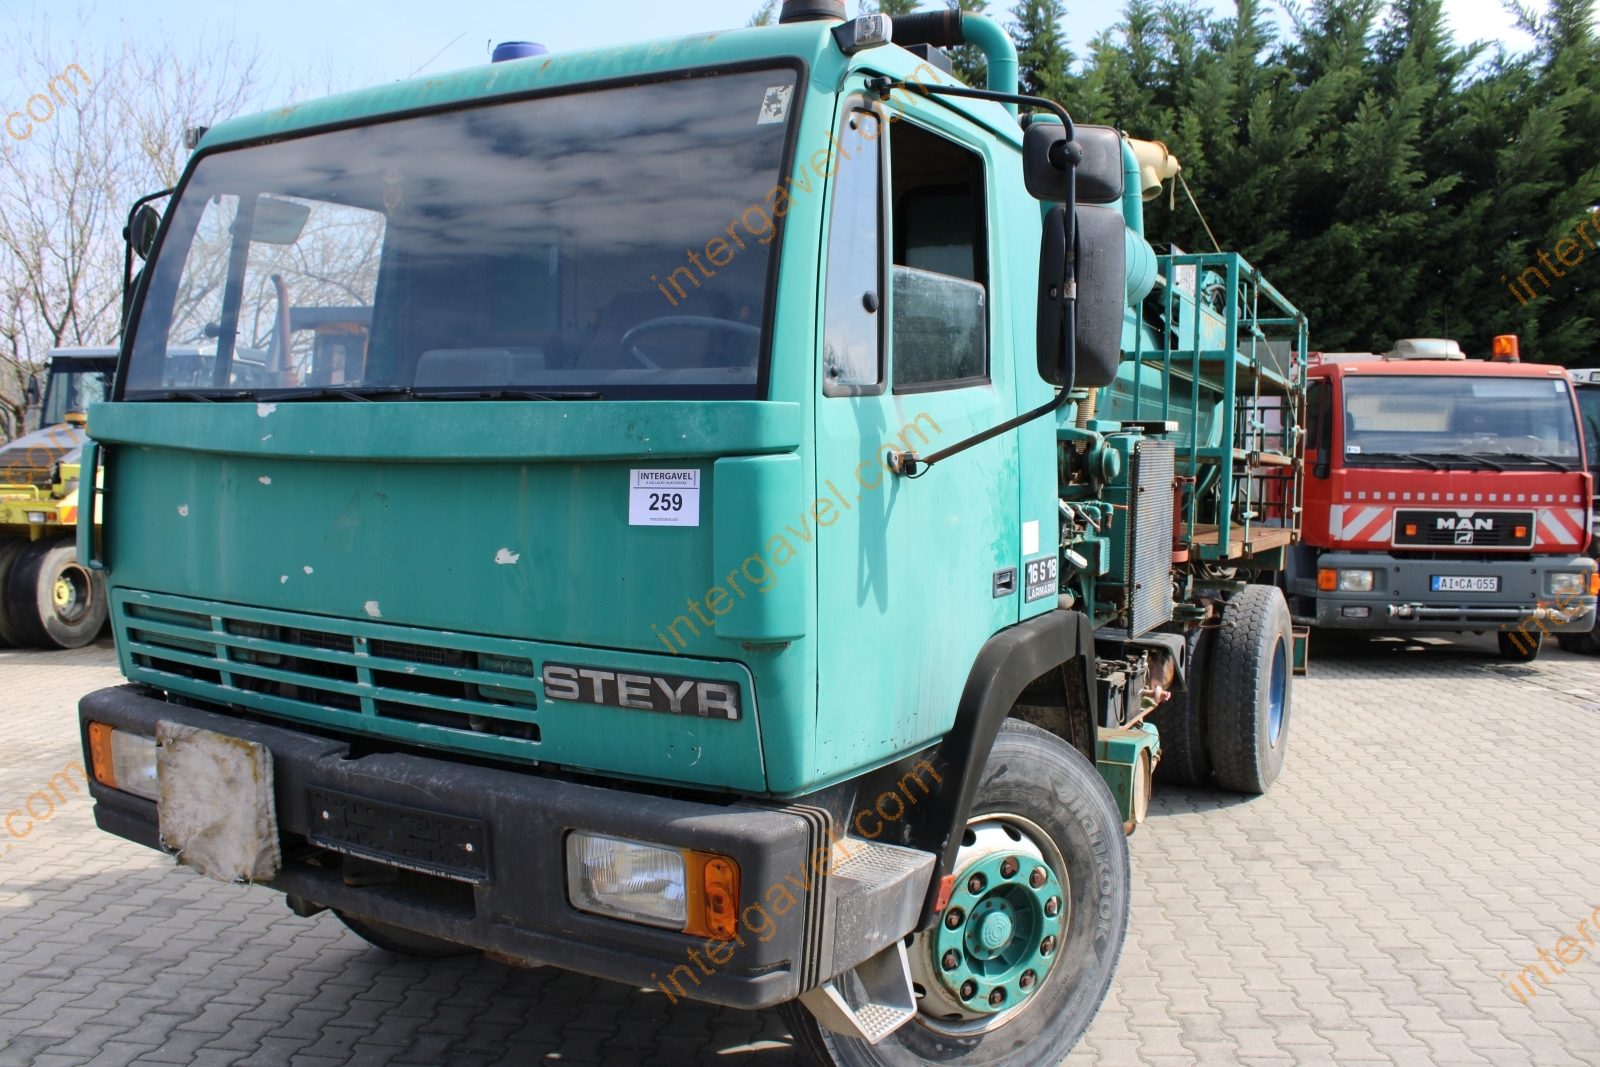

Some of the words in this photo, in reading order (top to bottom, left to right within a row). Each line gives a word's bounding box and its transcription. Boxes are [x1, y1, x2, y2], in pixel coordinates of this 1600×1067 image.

[640, 472, 693, 480] INTERGAVEL
[649, 493, 683, 511] 259
[1436, 518, 1493, 530] MAN
[1028, 563, 1039, 584] 16
[1040, 561, 1046, 581] S
[1047, 558, 1057, 579] 18
[1441, 578, 1453, 589] AI
[1459, 578, 1495, 590] CA-055
[543, 666, 738, 720] STEYR
